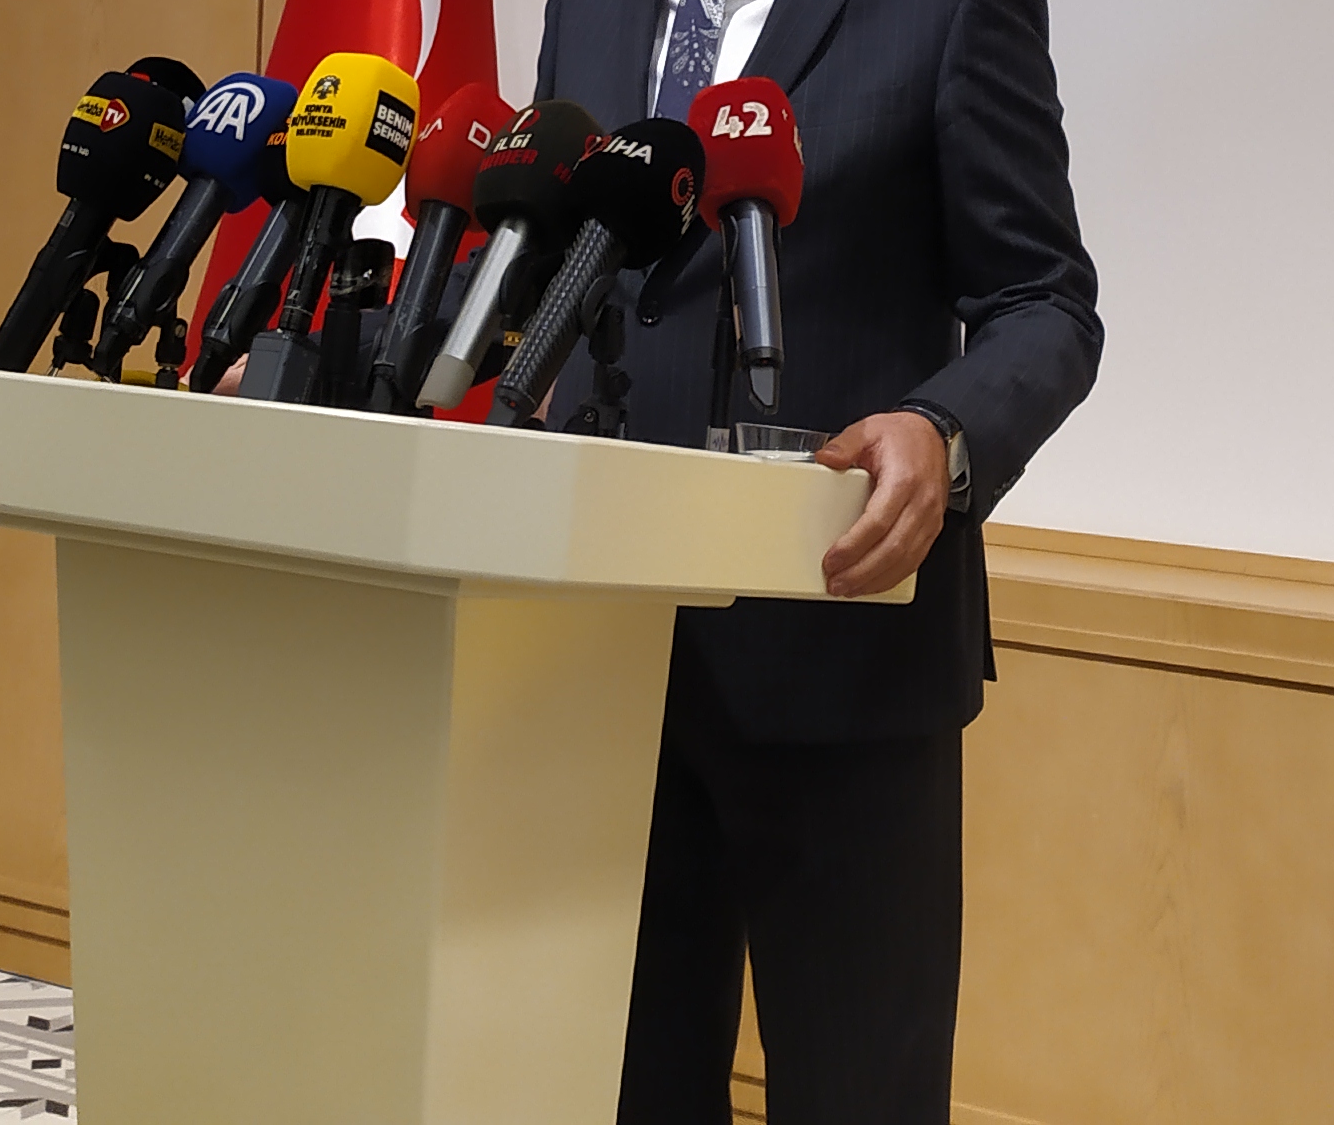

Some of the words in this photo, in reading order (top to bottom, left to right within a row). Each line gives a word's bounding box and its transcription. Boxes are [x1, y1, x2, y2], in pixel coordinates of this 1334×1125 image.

[105, 107, 125, 124] TV
[187, 91, 250, 141] AA
[304, 104, 333, 114] KONYA
[377, 104, 413, 136] BENİM
[711, 101, 772, 139] 42
[373, 122, 410, 152] ŞEHRİM
